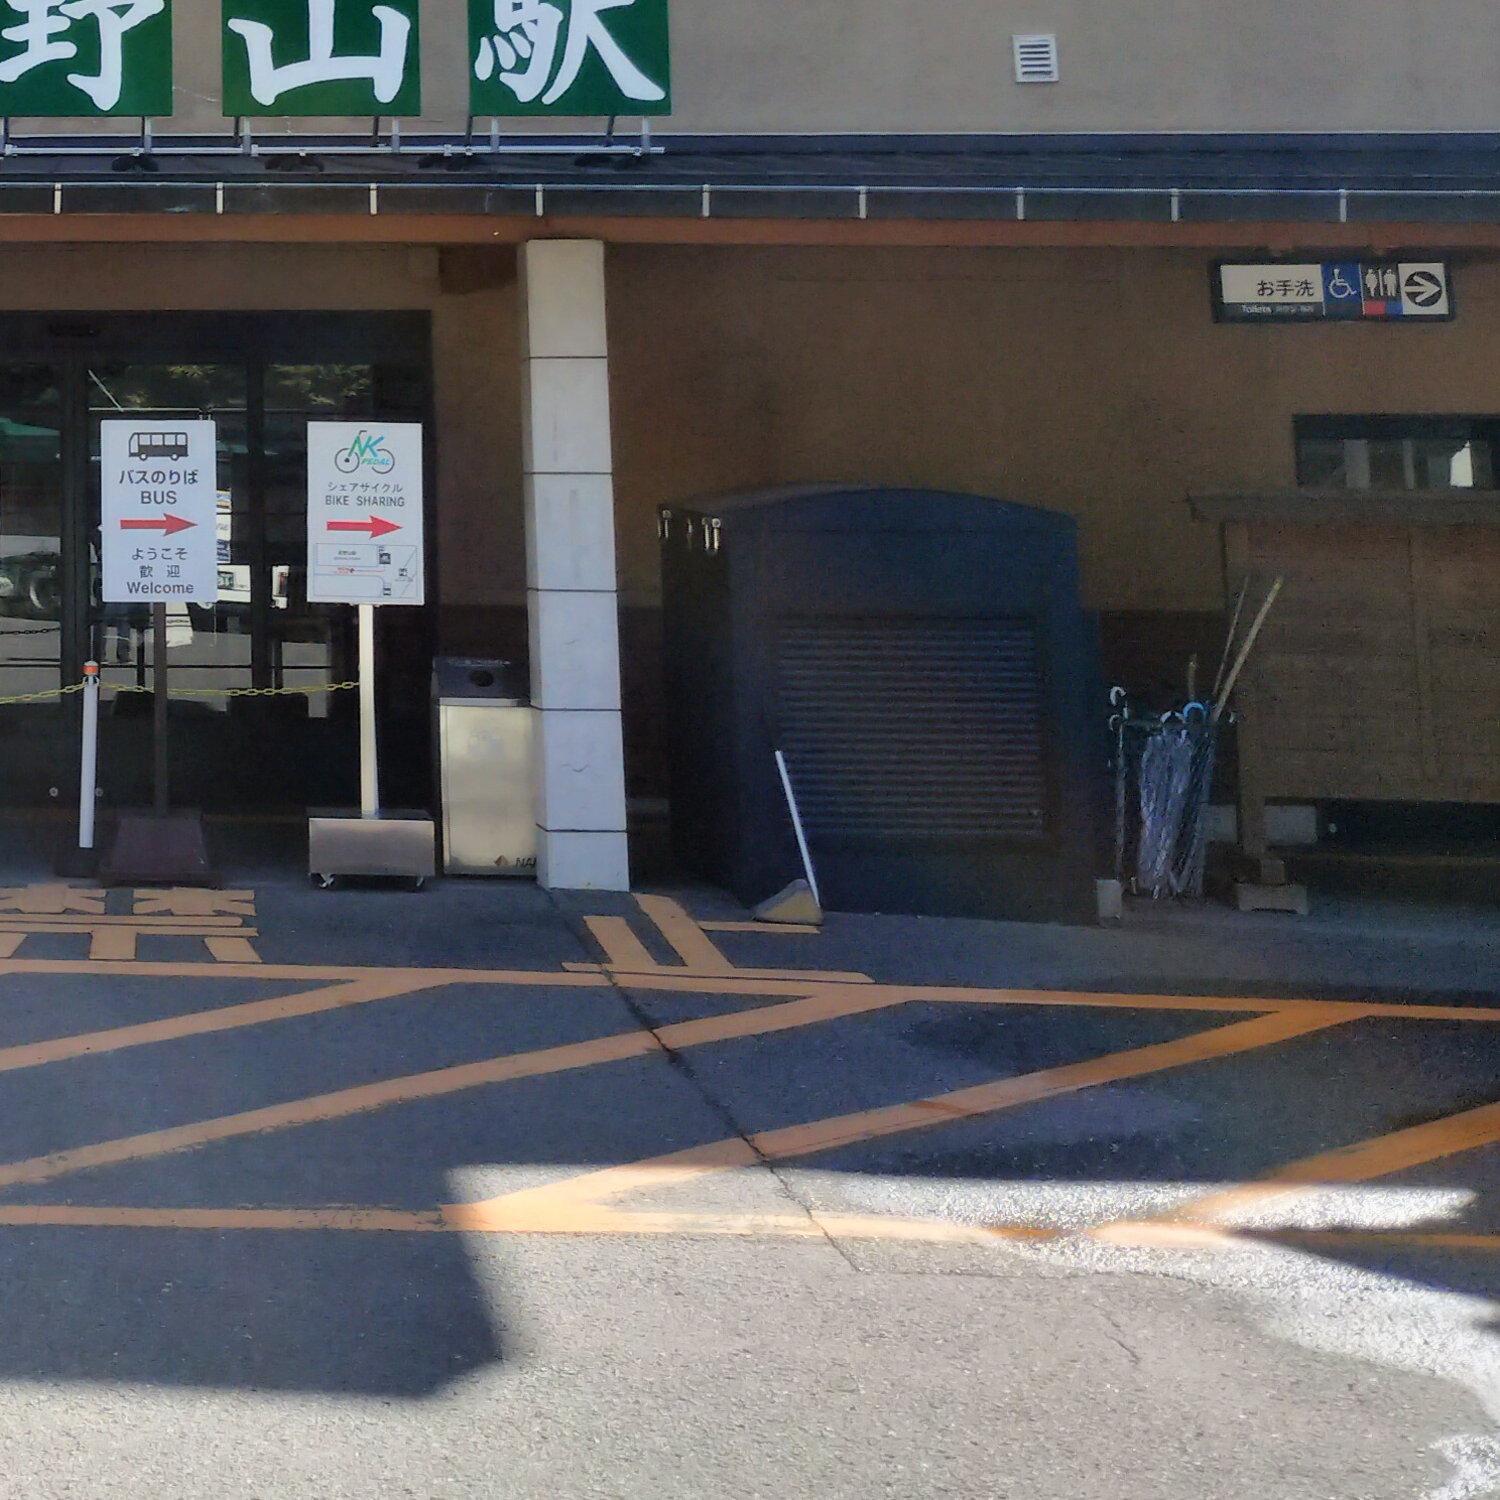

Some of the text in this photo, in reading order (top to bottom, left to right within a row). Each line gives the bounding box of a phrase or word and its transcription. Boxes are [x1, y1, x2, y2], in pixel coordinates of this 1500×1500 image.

[1256, 278, 1315, 298] お手洗
[347, 434, 385, 458] NK
[361, 457, 391, 467] PEDAL
[119, 468, 199, 485] バスのりば
[327, 481, 404, 495] シェアサイクル
[140, 489, 178, 506] BUS
[325, 494, 406, 508] BIKE SHARING
[131, 546, 189, 561] ようこそ
[126, 581, 195, 595] Welcome
